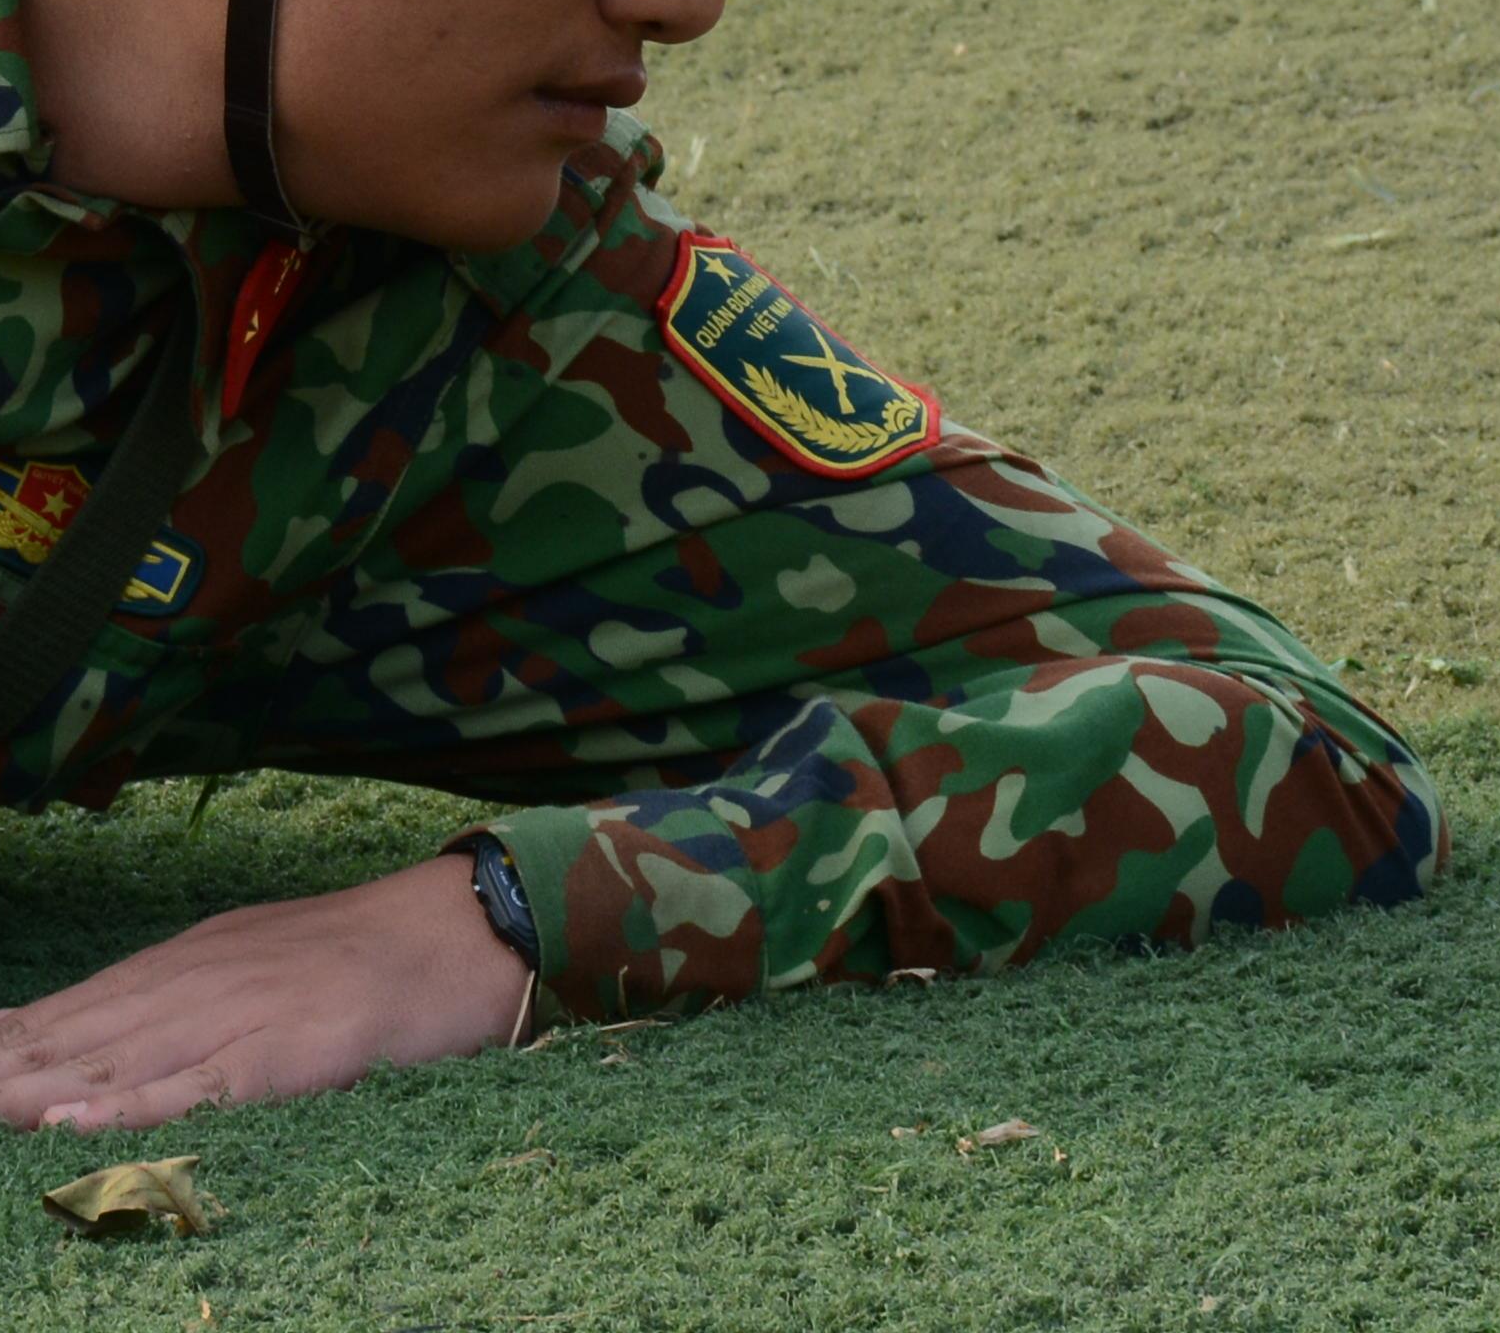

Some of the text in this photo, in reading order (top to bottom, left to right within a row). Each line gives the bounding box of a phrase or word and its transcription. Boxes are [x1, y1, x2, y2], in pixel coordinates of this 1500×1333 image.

[695, 306, 737, 349] QUÂN
[726, 285, 755, 315] ĐỘI
[745, 310, 780, 341] VIỆT
